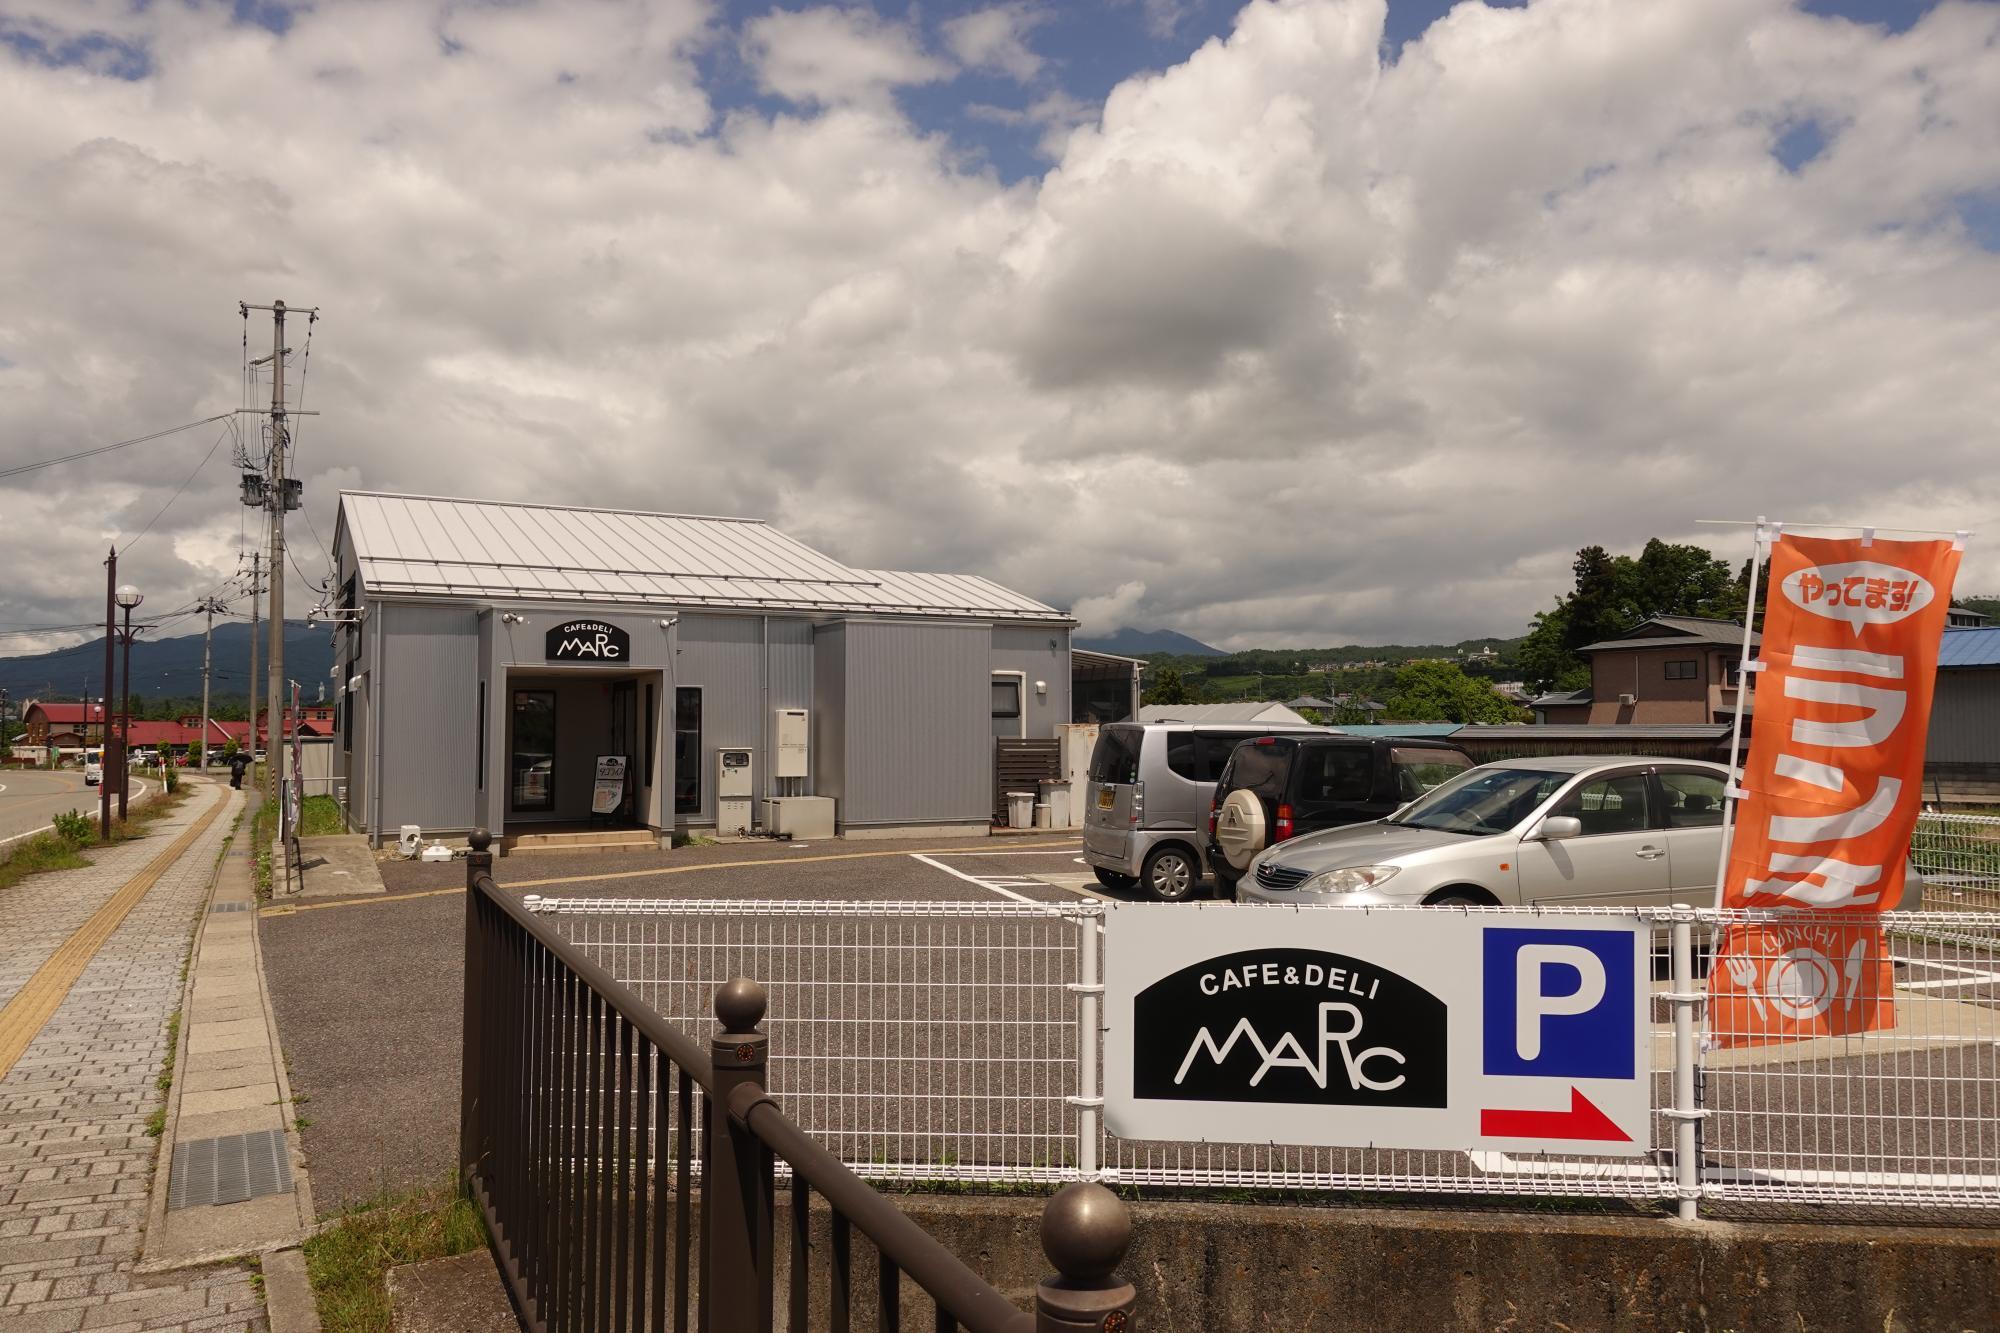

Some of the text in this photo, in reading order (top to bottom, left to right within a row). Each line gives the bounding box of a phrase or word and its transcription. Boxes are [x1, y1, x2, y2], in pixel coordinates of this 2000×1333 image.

[1798, 573, 1919, 612] やってます!
[564, 623, 613, 634] CAFE&DELI
[1761, 926, 1837, 953] LUNCH!
[1199, 962, 1381, 1000] CAFE&DELI
[1516, 943, 1607, 1061] P
